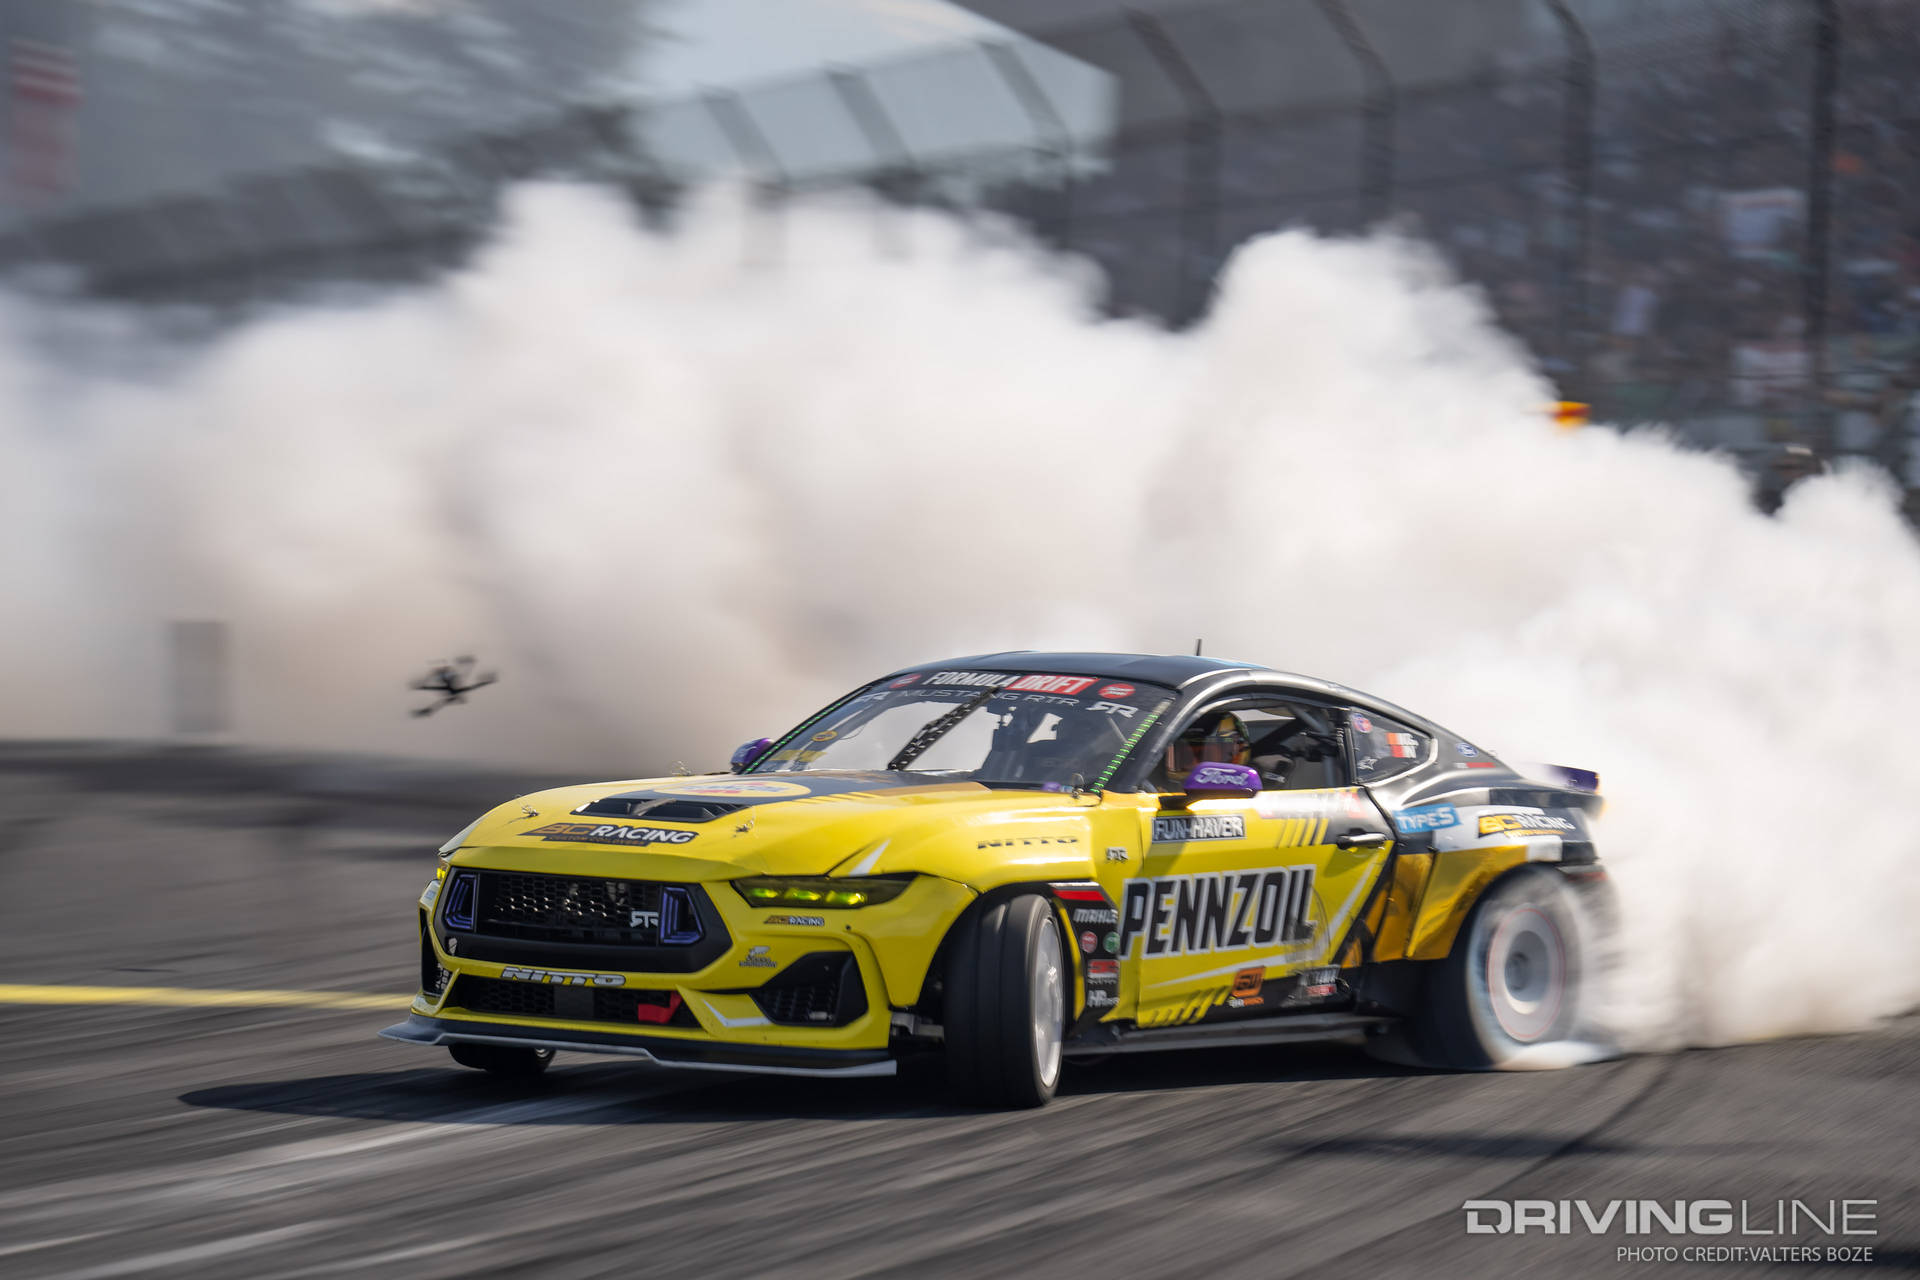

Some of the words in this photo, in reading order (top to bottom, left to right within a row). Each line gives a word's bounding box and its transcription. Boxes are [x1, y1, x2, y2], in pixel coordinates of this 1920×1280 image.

[922, 672, 1020, 687] FORMULA
[1016, 675, 1092, 693] DRIFT
[1024, 692, 1080, 706] RTR
[1195, 768, 1250, 785] Ford
[1154, 817, 1243, 840] FUN-HAVER
[1120, 866, 1316, 957] PENNZOIL
[502, 967, 626, 987] NITTO
